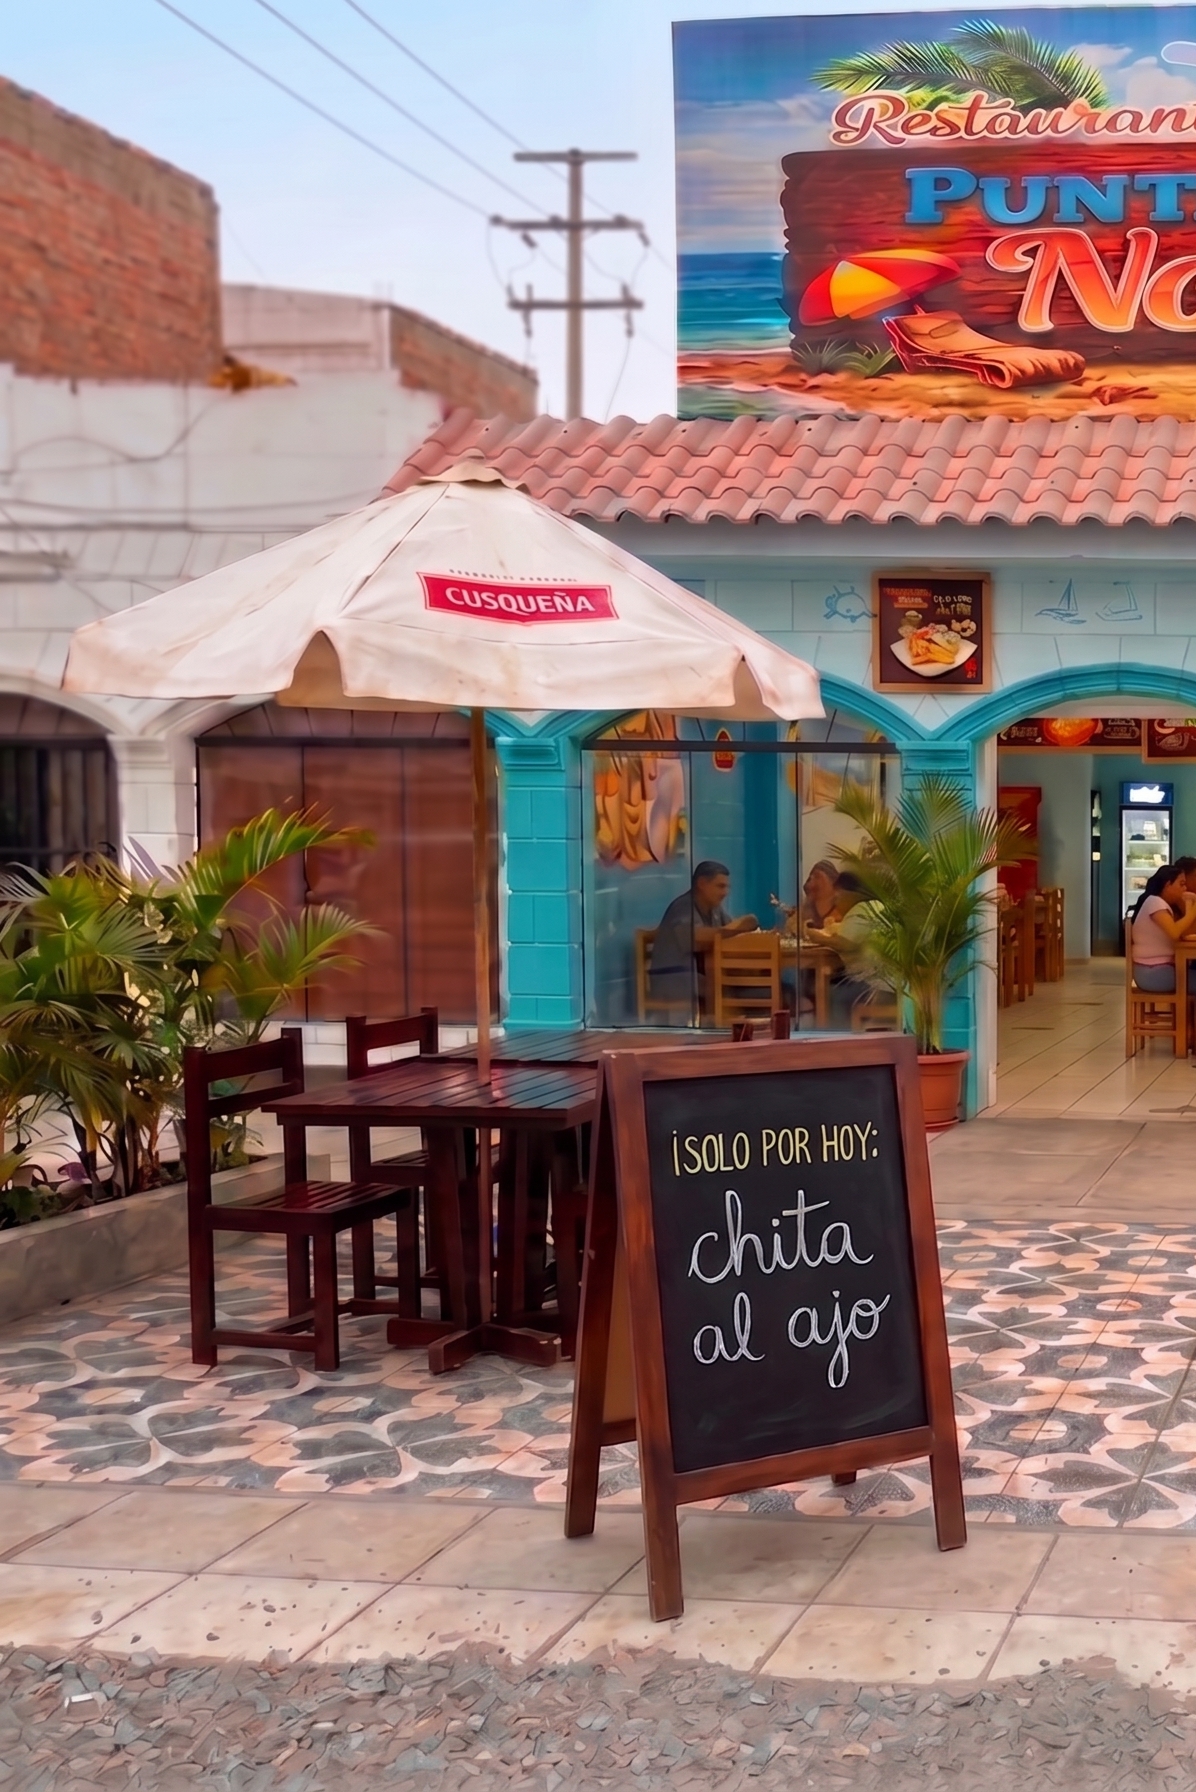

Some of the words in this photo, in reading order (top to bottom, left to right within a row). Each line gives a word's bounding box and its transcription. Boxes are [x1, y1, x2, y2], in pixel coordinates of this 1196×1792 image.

[445, 587, 596, 616] CUSQUEÑA
[672, 1130, 751, 1176] ¡SOLO
[761, 1126, 812, 1167] POR
[821, 1121, 879, 1163] HOY:
[687, 1189, 875, 1285] chita
[693, 1291, 766, 1364] al
[788, 1289, 892, 1389] ajo
